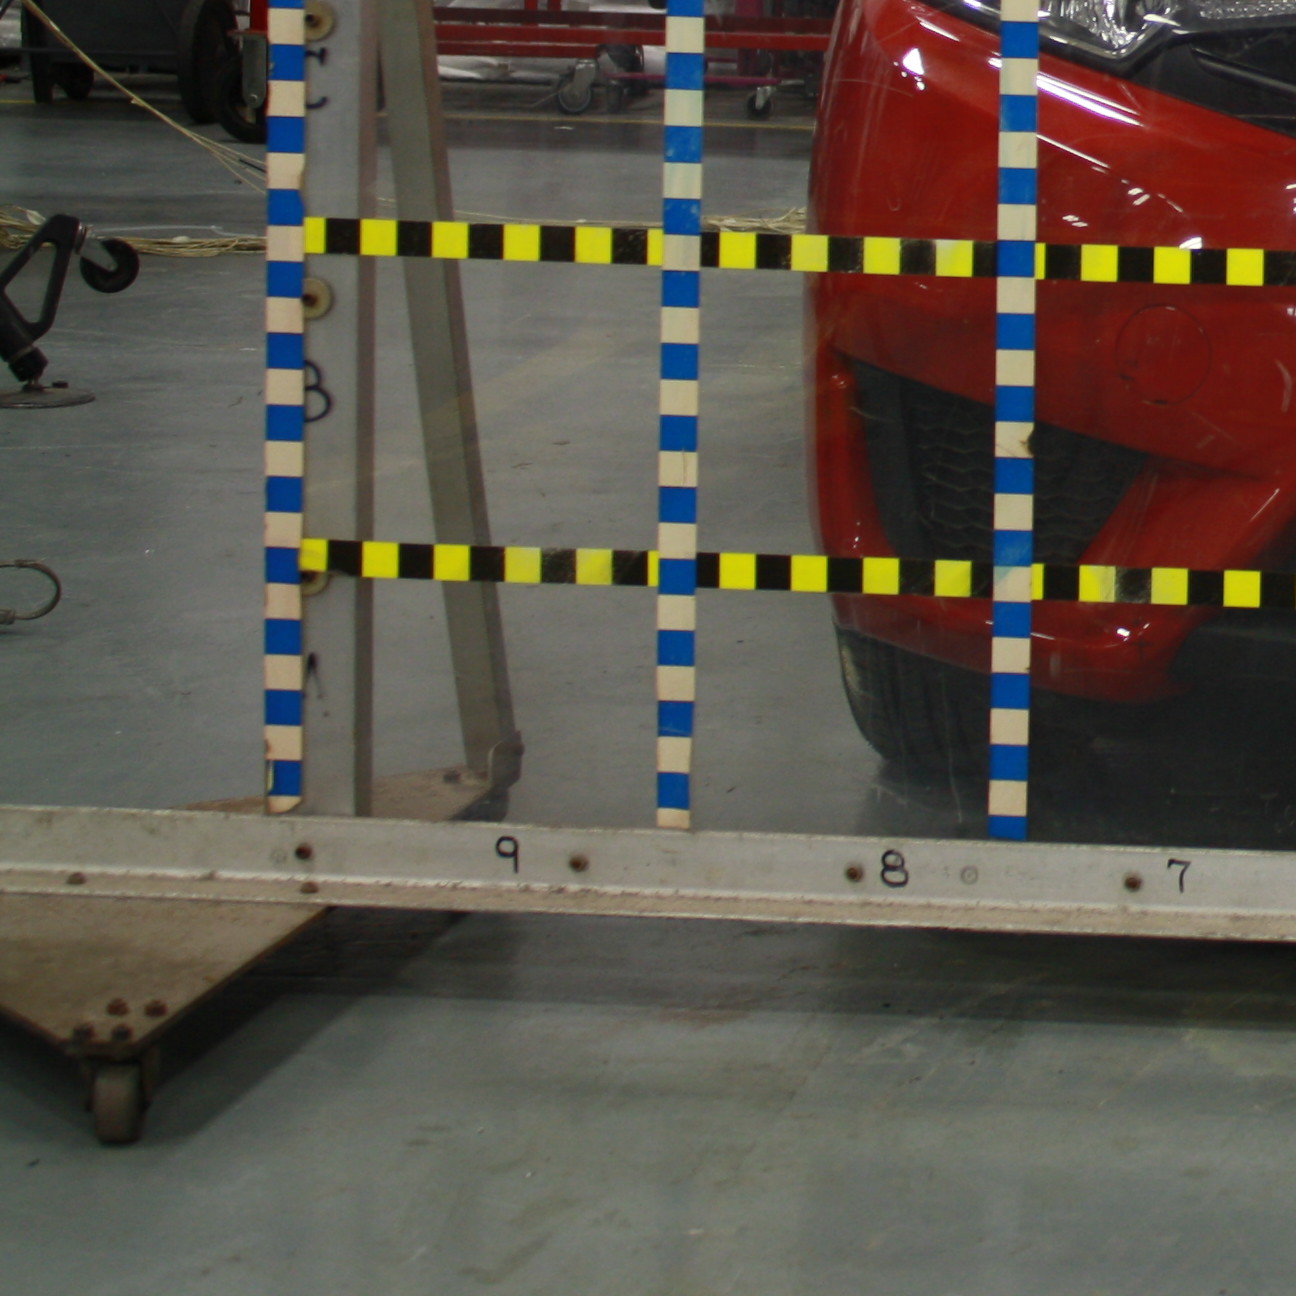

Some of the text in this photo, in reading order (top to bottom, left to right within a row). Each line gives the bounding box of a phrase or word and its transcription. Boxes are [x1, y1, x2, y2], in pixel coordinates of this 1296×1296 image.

[494, 835, 520, 874] 9
[880, 848, 910, 889] 8
[1166, 858, 1191, 894] 7
